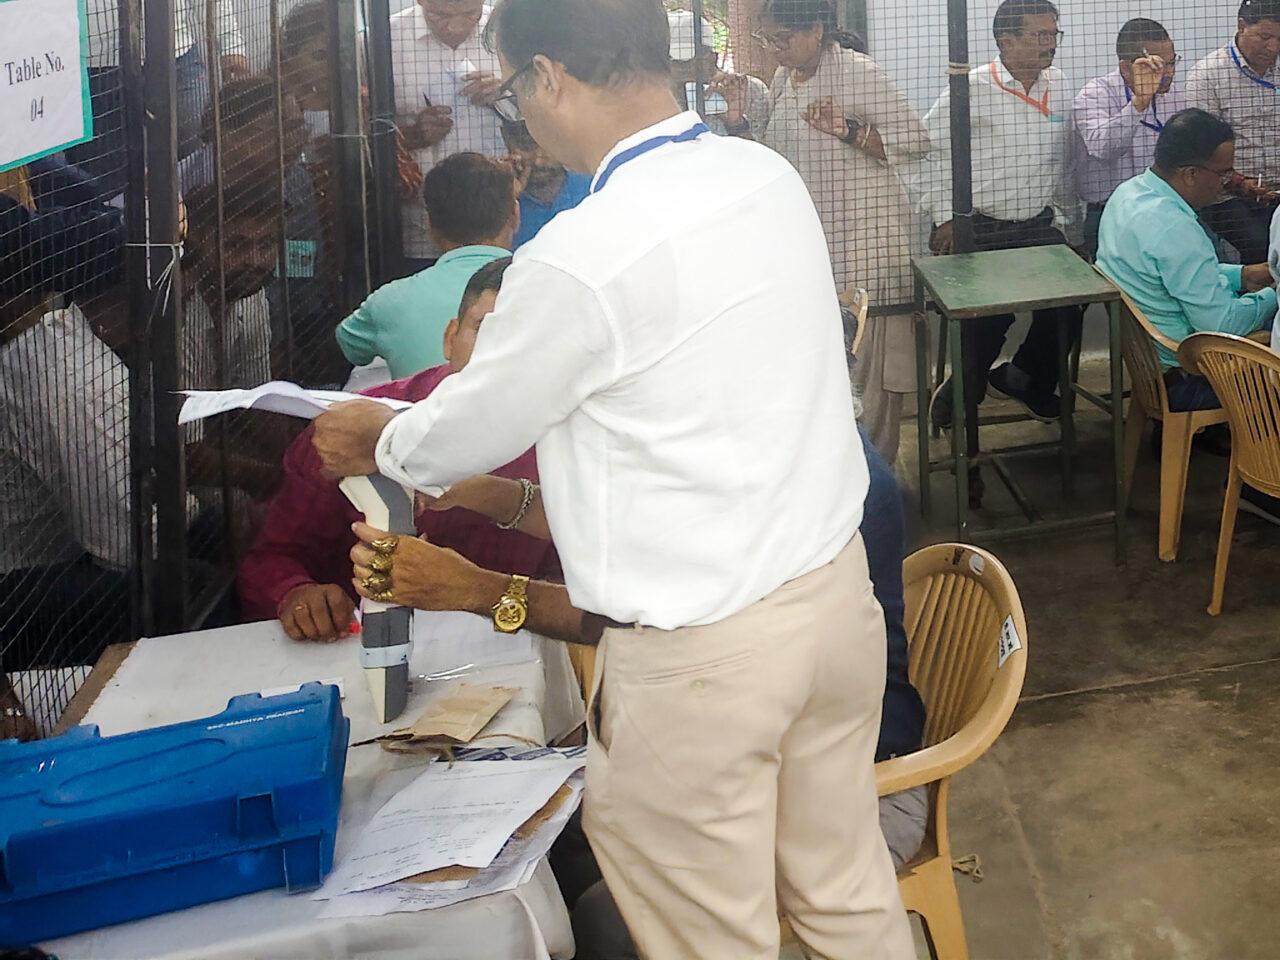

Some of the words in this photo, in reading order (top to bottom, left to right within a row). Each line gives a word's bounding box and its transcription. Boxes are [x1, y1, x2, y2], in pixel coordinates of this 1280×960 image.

[4, 56, 42, 85] Table
[44, 51, 65, 75] No.
[30, 96, 45, 122] 04
